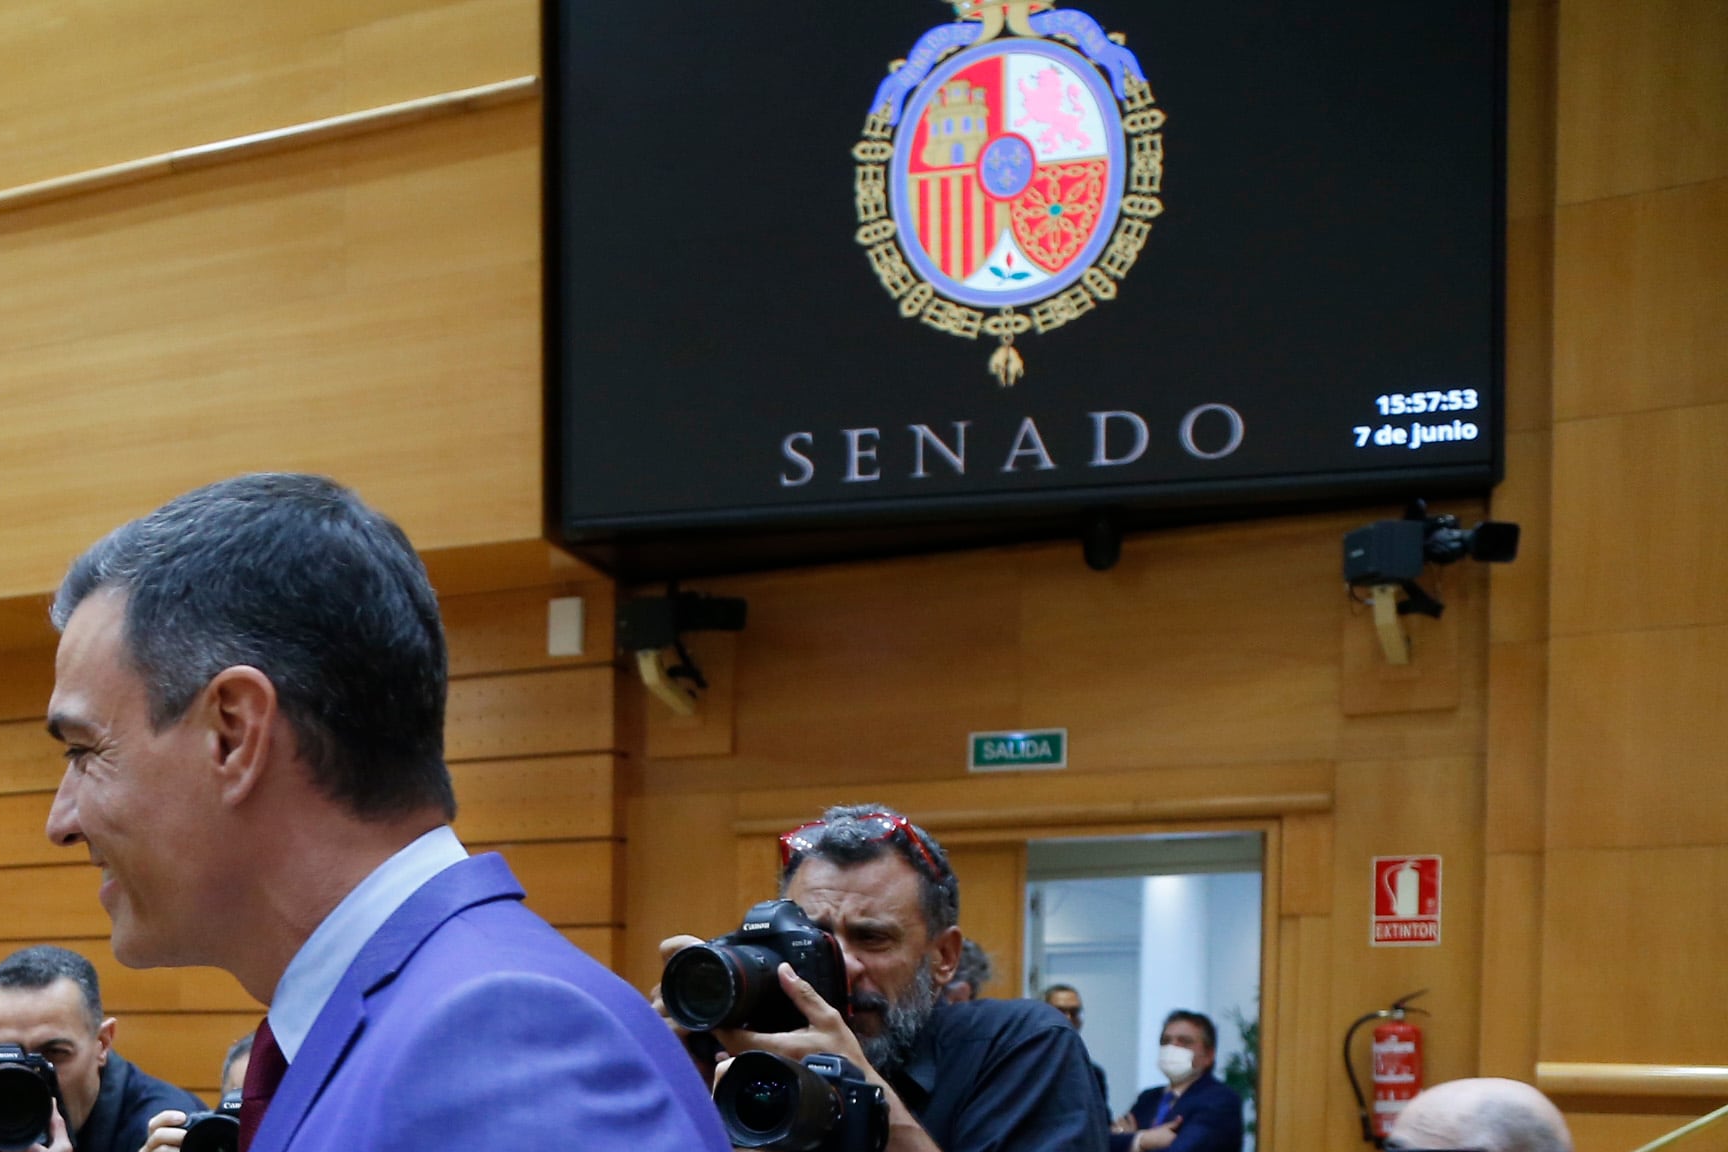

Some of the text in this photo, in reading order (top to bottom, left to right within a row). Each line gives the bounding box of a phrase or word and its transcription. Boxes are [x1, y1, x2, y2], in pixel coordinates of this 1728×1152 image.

[1376, 388, 1478, 415] 15:57:53
[780, 402, 1246, 487] SENADO
[1353, 419, 1478, 449] 7 de junio
[983, 739, 1052, 760] SALIDA
[743, 922, 770, 931] Canon
[1376, 922, 1439, 939] EXTINTOR
